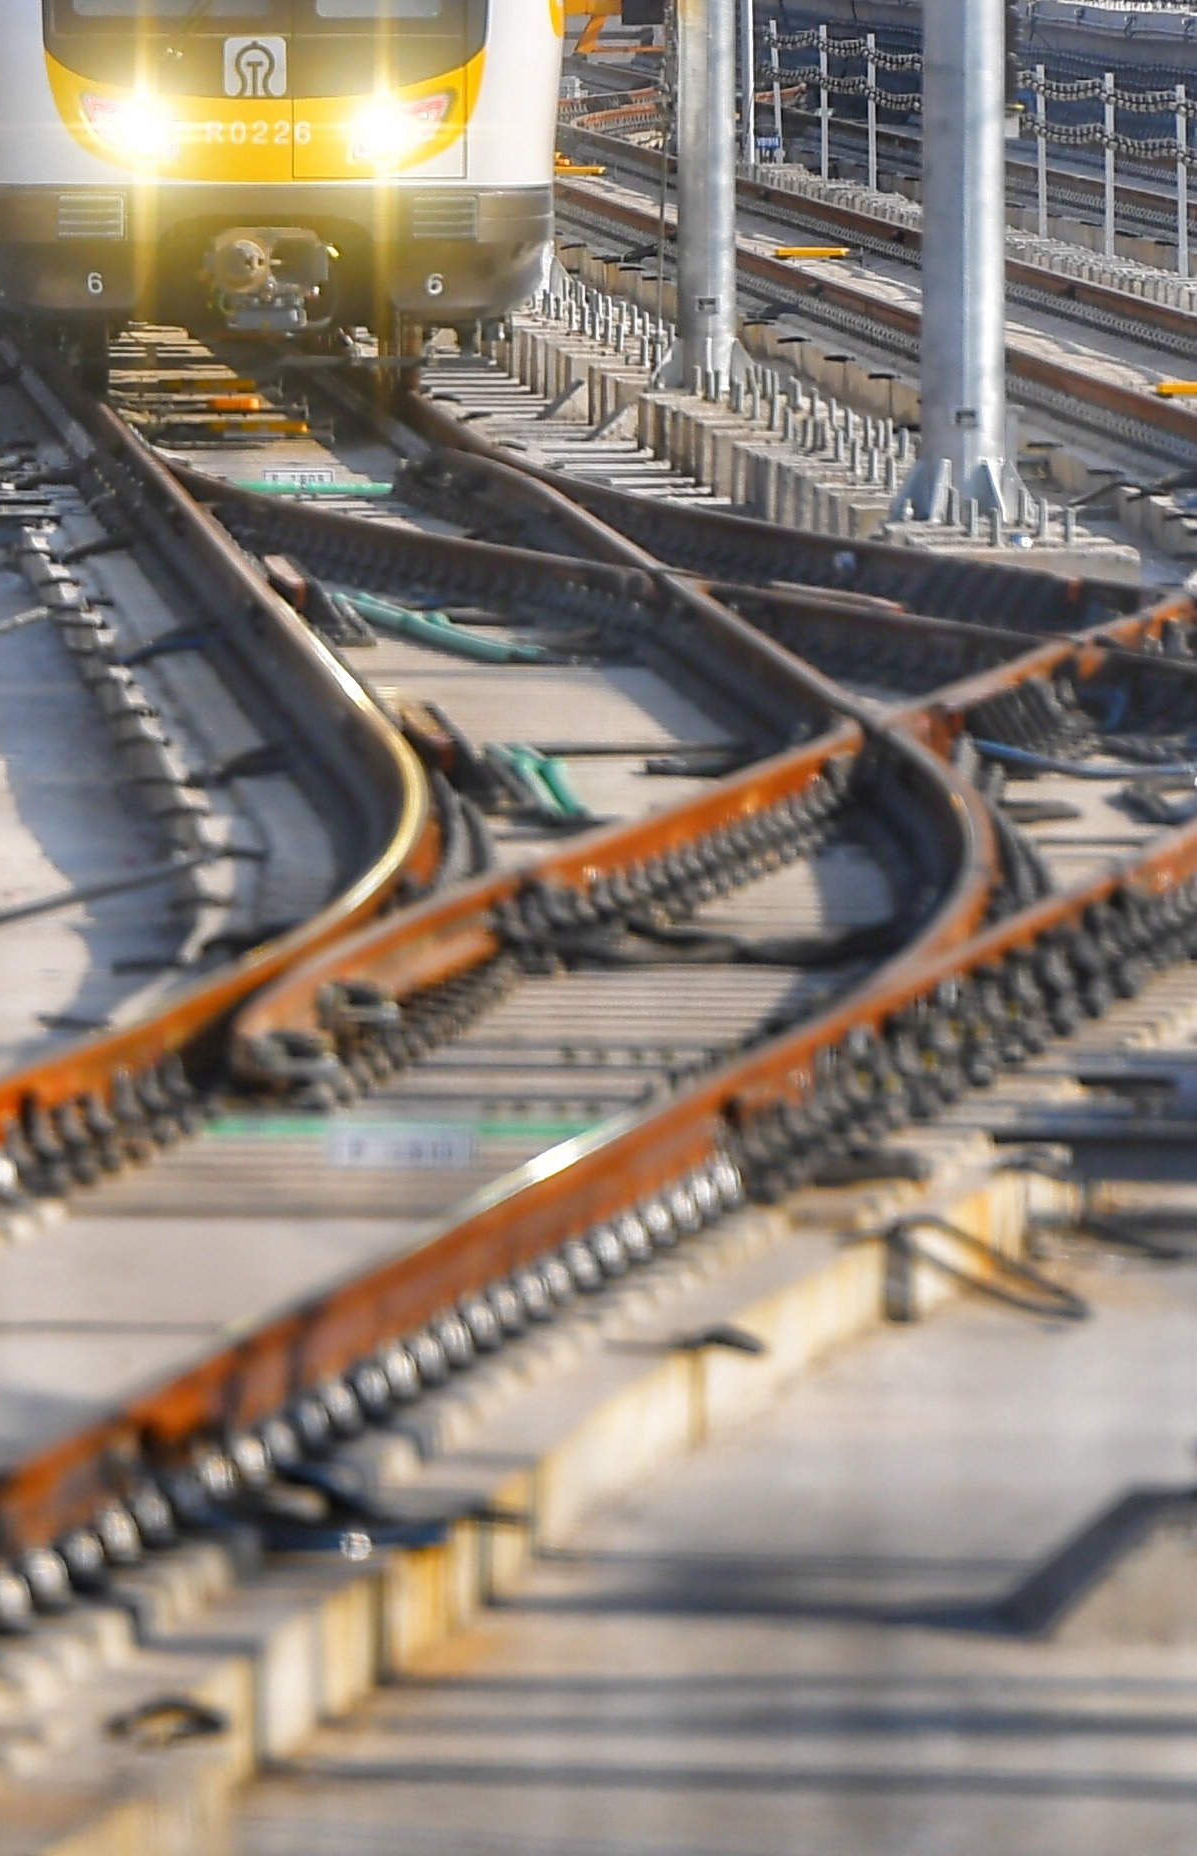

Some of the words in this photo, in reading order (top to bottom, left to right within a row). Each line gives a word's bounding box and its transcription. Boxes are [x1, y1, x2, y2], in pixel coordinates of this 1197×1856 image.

[205, 121, 312, 145] R0226
[86, 272, 104, 294] 6
[426, 272, 444, 295] 6
